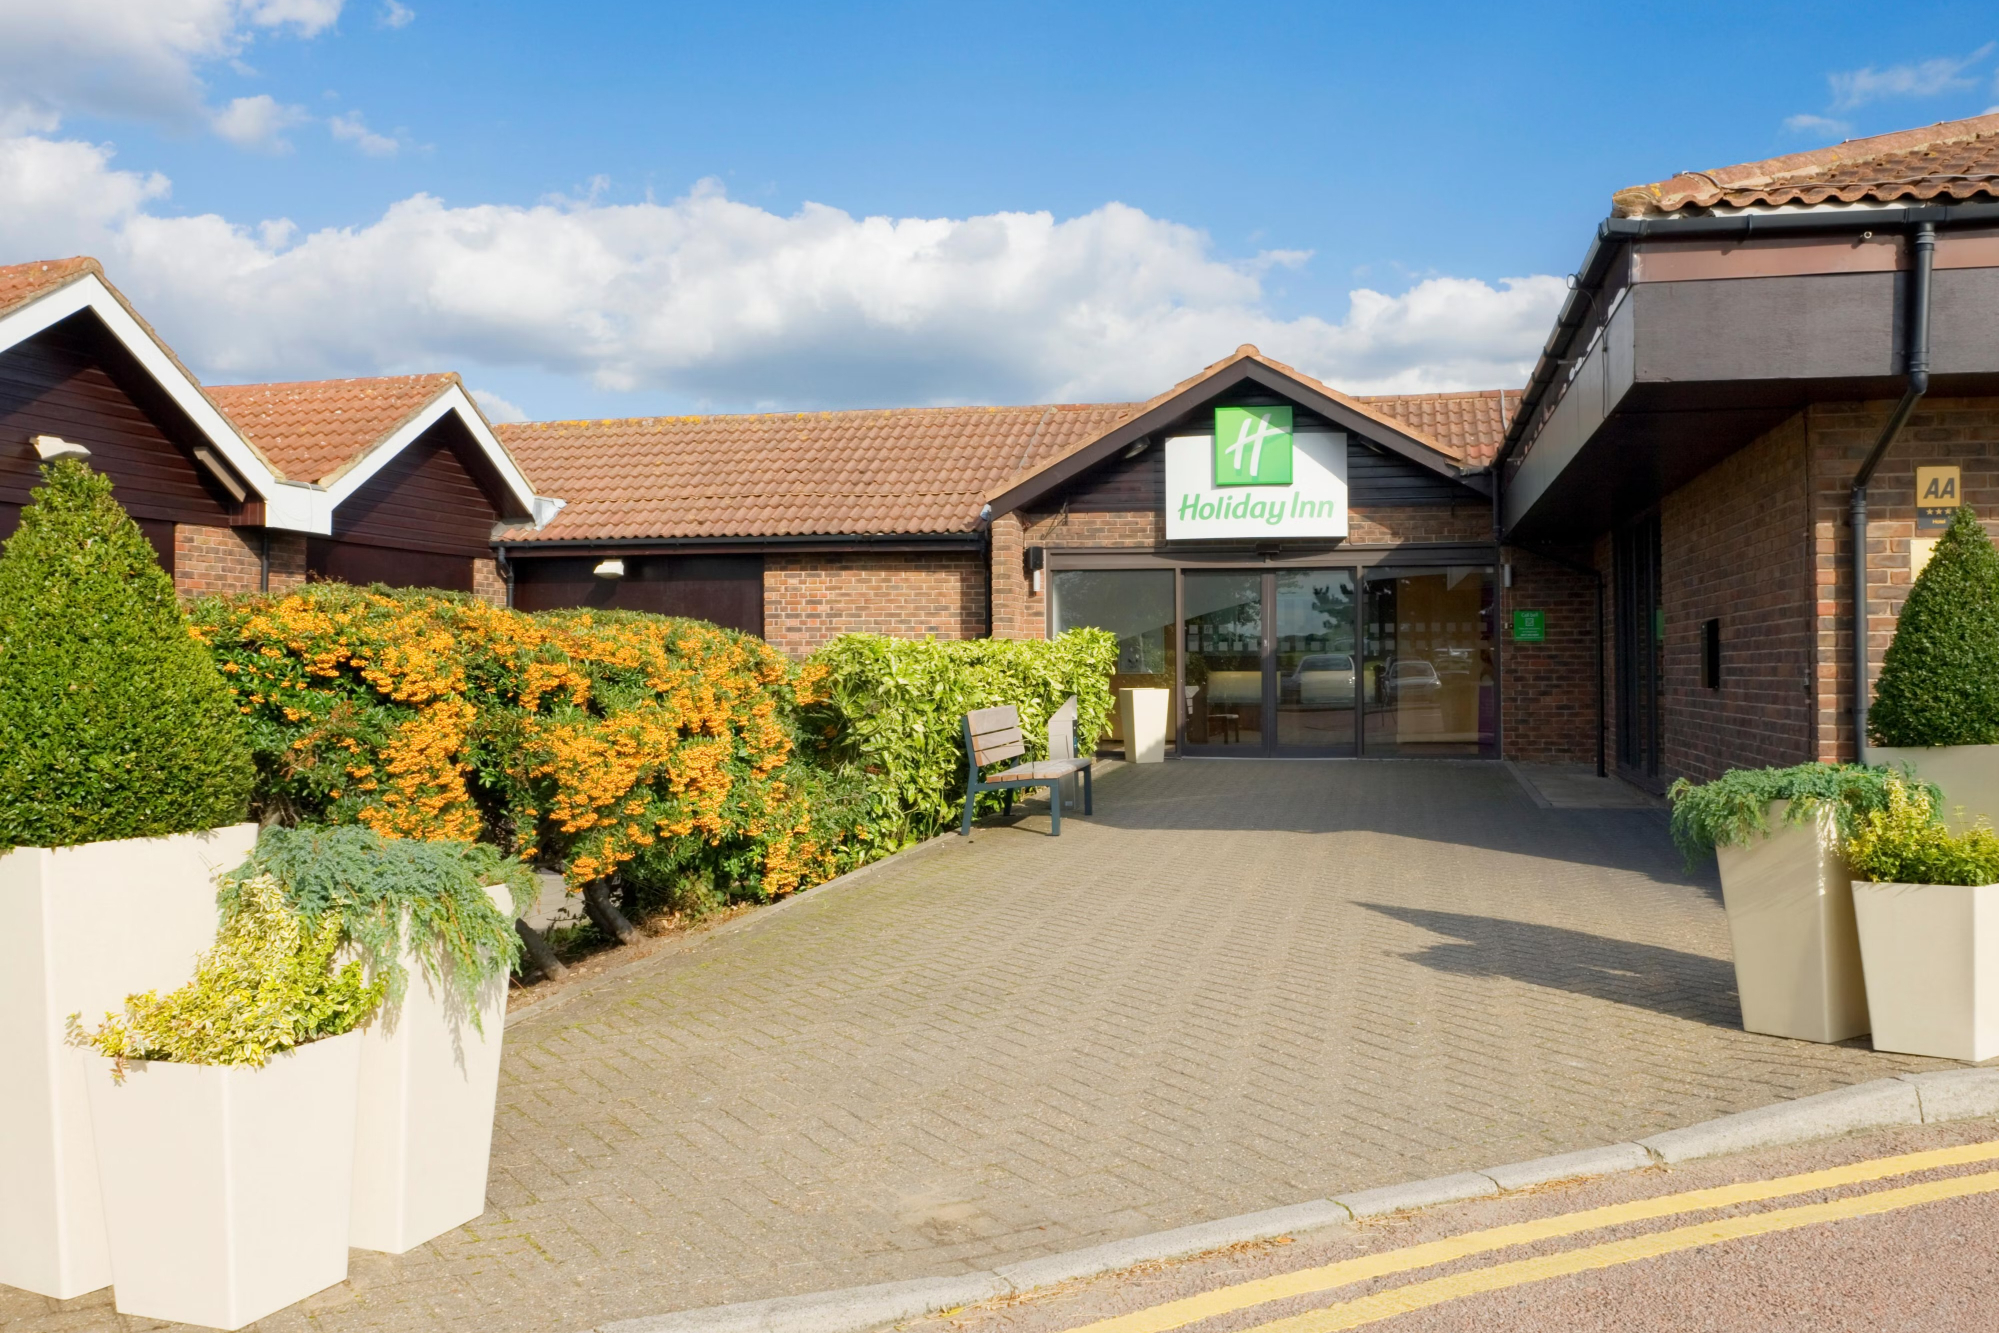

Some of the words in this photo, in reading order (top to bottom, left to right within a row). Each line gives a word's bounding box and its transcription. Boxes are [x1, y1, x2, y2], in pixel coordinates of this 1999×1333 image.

[1923, 477, 1955, 499] AA
[1178, 492, 1286, 525] Holiday
[1290, 491, 1335, 519] Inn
